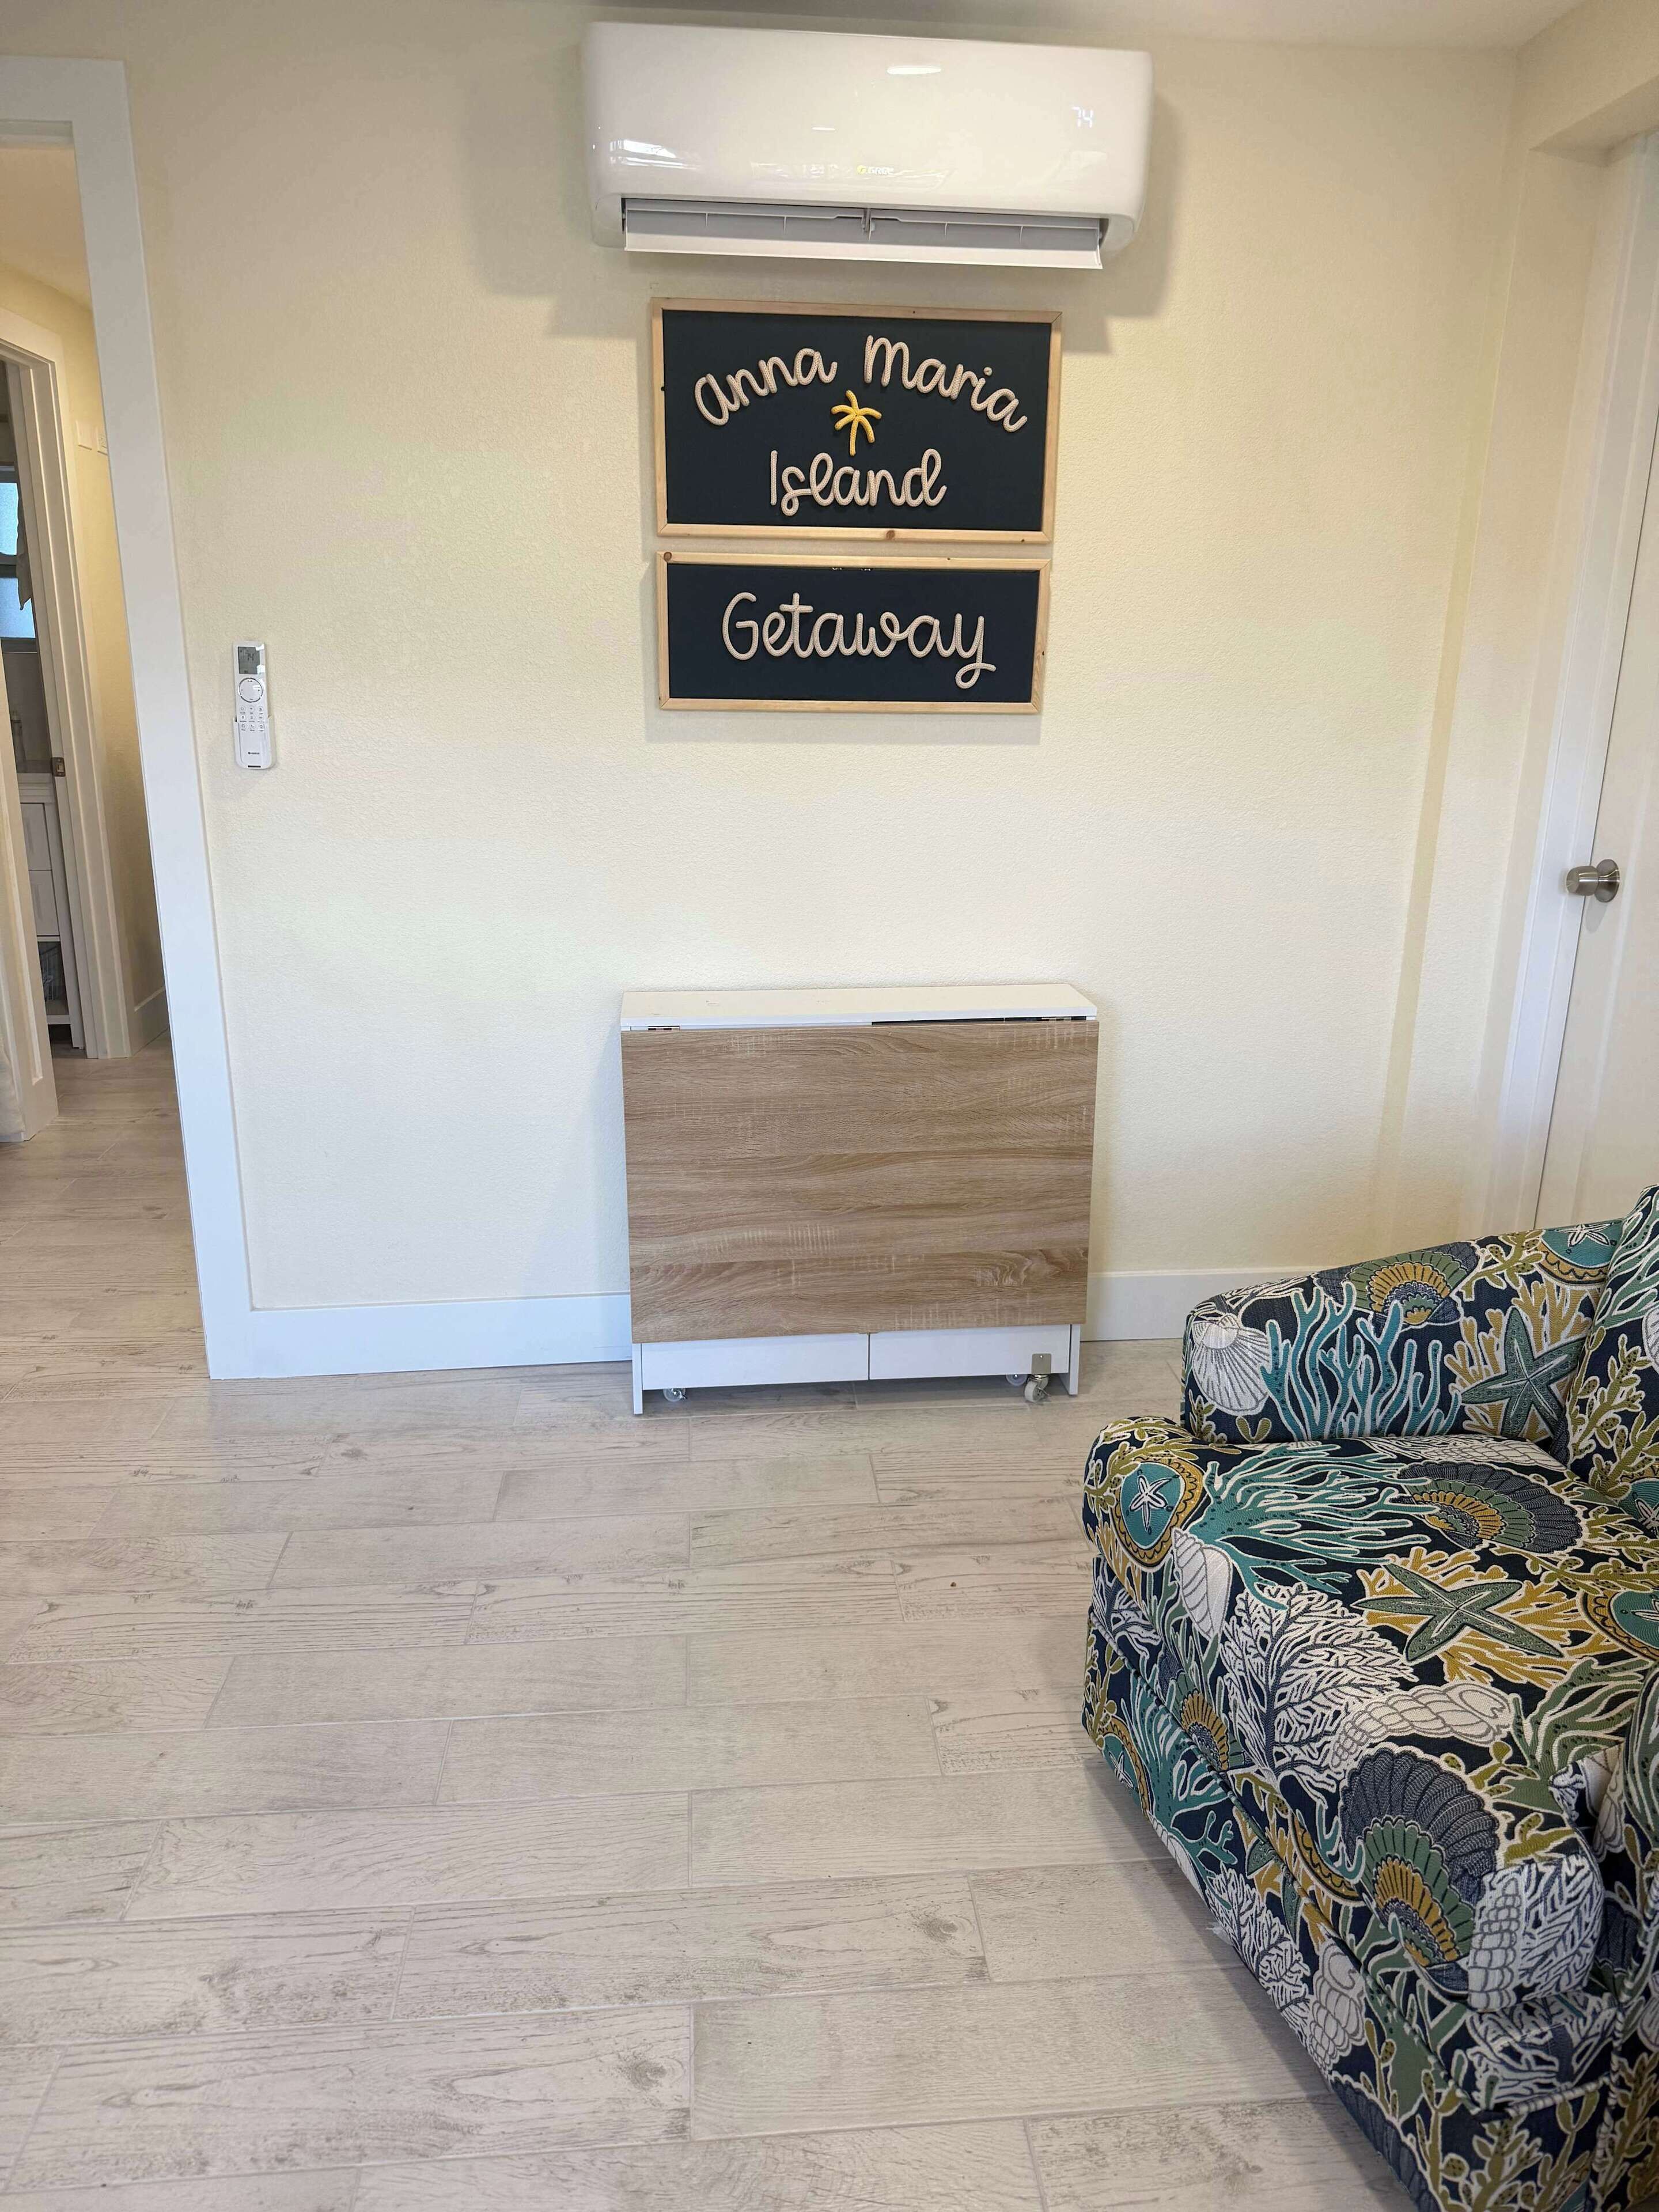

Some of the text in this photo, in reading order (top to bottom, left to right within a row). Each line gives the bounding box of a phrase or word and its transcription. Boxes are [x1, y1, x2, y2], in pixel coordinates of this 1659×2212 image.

[1071, 106, 1093, 128] 74
[864, 335, 1027, 432] Maria
[770, 448, 947, 516] Island
[722, 592, 997, 690] Getaway
